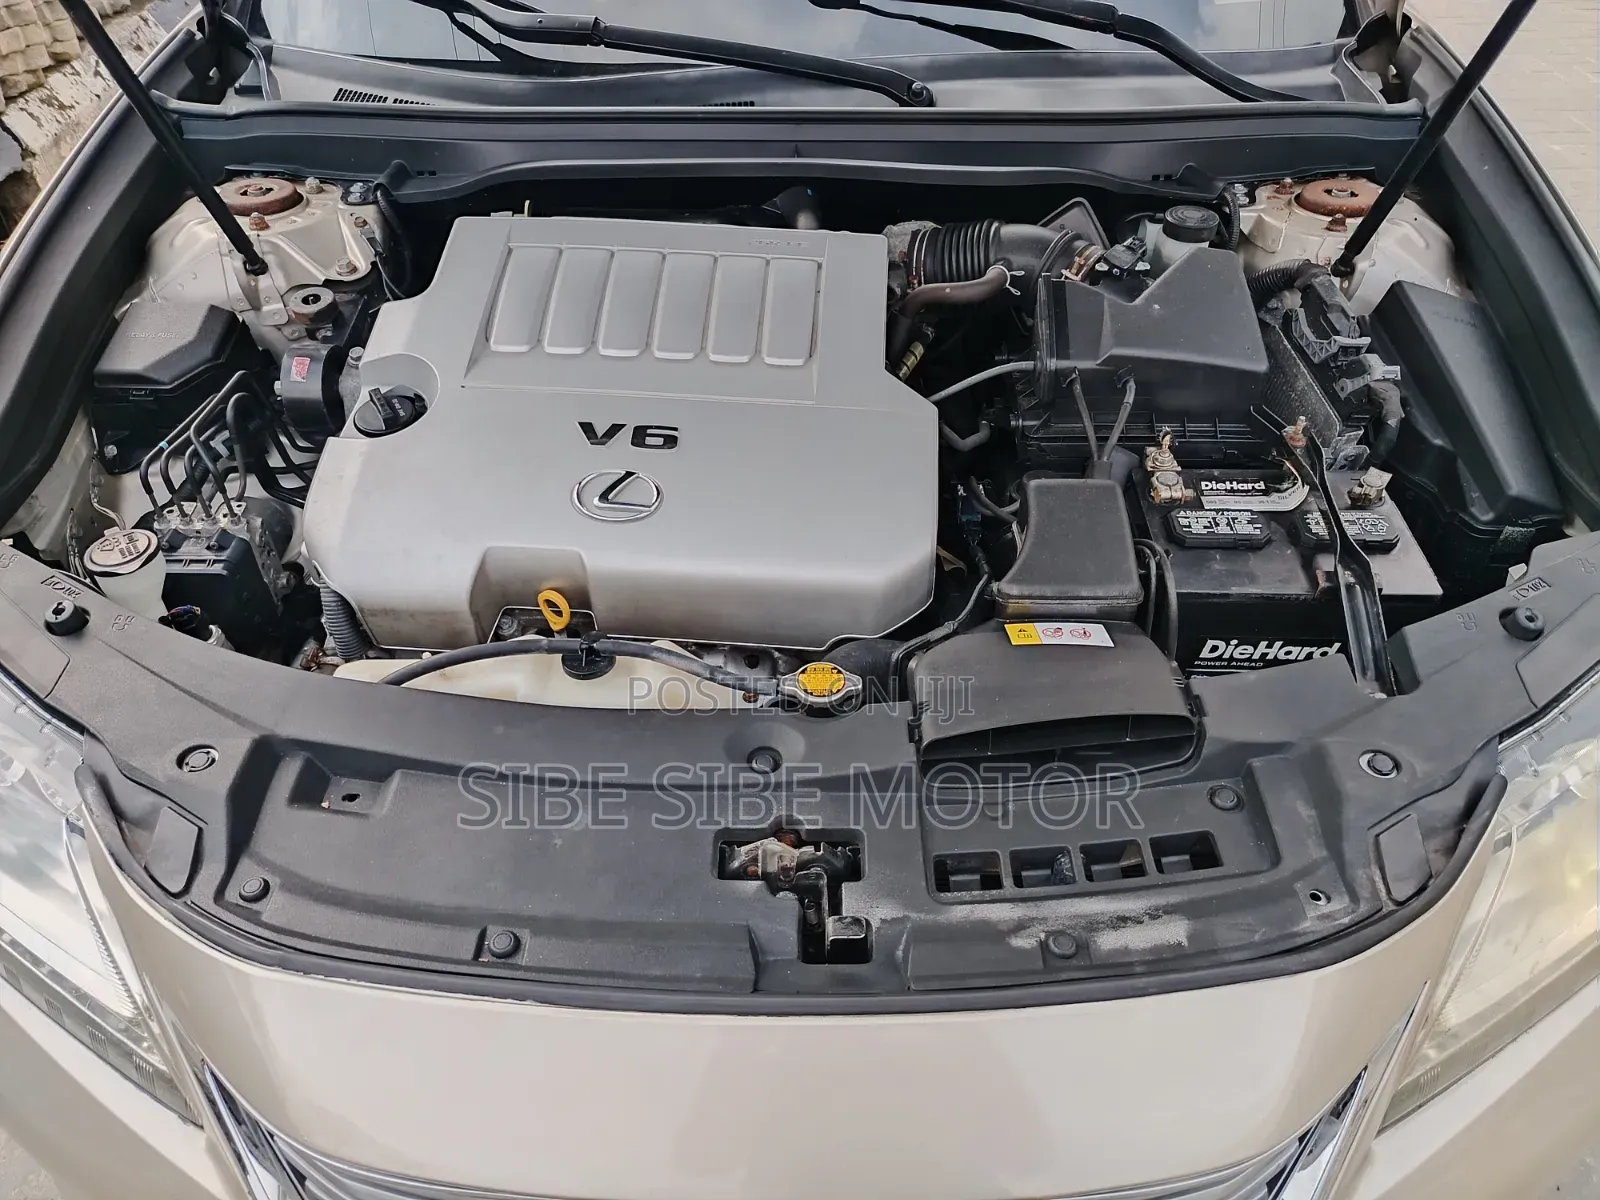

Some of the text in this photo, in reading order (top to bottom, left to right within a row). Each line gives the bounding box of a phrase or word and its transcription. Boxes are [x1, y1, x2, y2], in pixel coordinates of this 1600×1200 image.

[577, 421, 679, 450] V6
[1200, 481, 1265, 490] DieHard
[1199, 639, 1342, 660] DieHard
